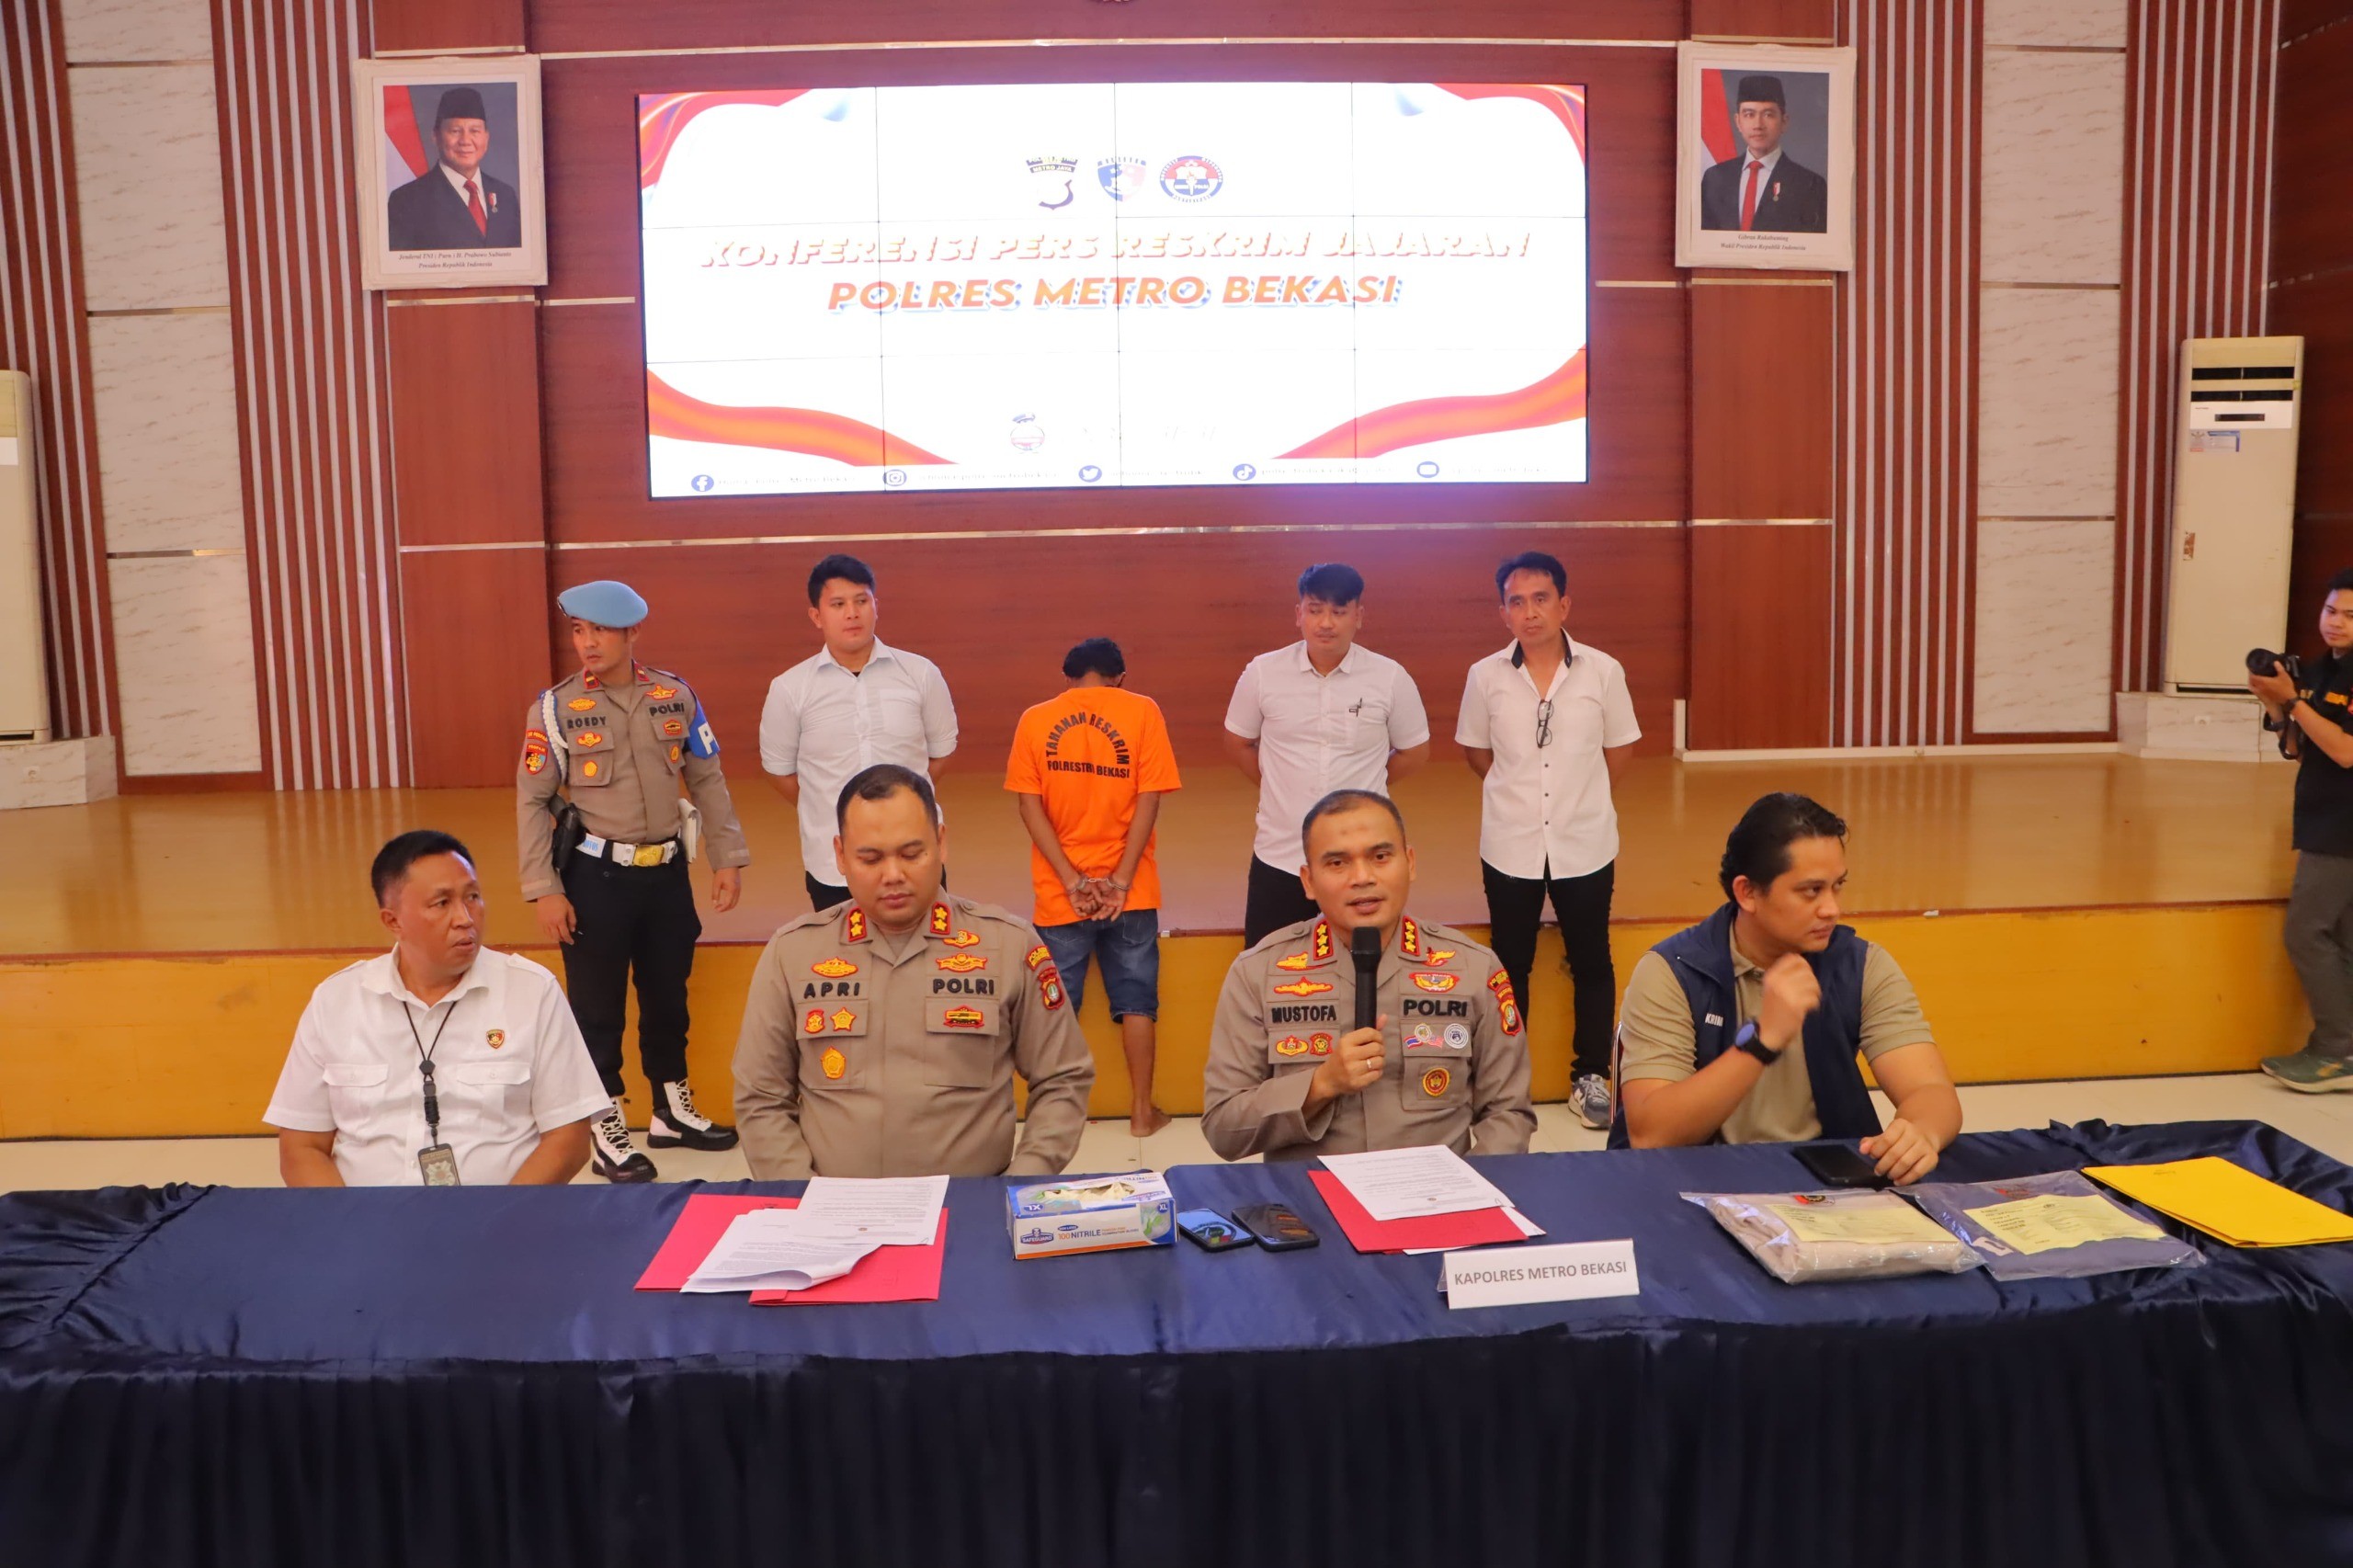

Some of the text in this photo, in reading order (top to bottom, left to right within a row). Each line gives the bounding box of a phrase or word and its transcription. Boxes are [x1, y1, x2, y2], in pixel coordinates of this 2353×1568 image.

[700, 234, 978, 267] KONFERENSI
[989, 234, 1098, 261] PERS
[1110, 232, 1311, 258] RESKRIM
[828, 276, 1403, 312] POLRES METRO BEKASI
[649, 702, 685, 717] POLRI
[566, 716, 607, 729] ROEDY
[1046, 711, 1130, 765] TAHANAN RESKRIM
[1047, 760, 1130, 778] POLRESTRI BEKASI
[803, 982, 860, 999] APRI
[932, 978, 995, 995] POLRI
[1271, 1005, 1337, 1023] MUSTOFA
[1404, 999, 1467, 1017] POLRI
[1705, 1013, 1723, 1027] KRIM
[1159, 1203, 1168, 1211] XL
[1071, 1230, 1101, 1239] NITRILE
[1454, 1261, 1627, 1286] KAPOLRES METRO BEKASI
